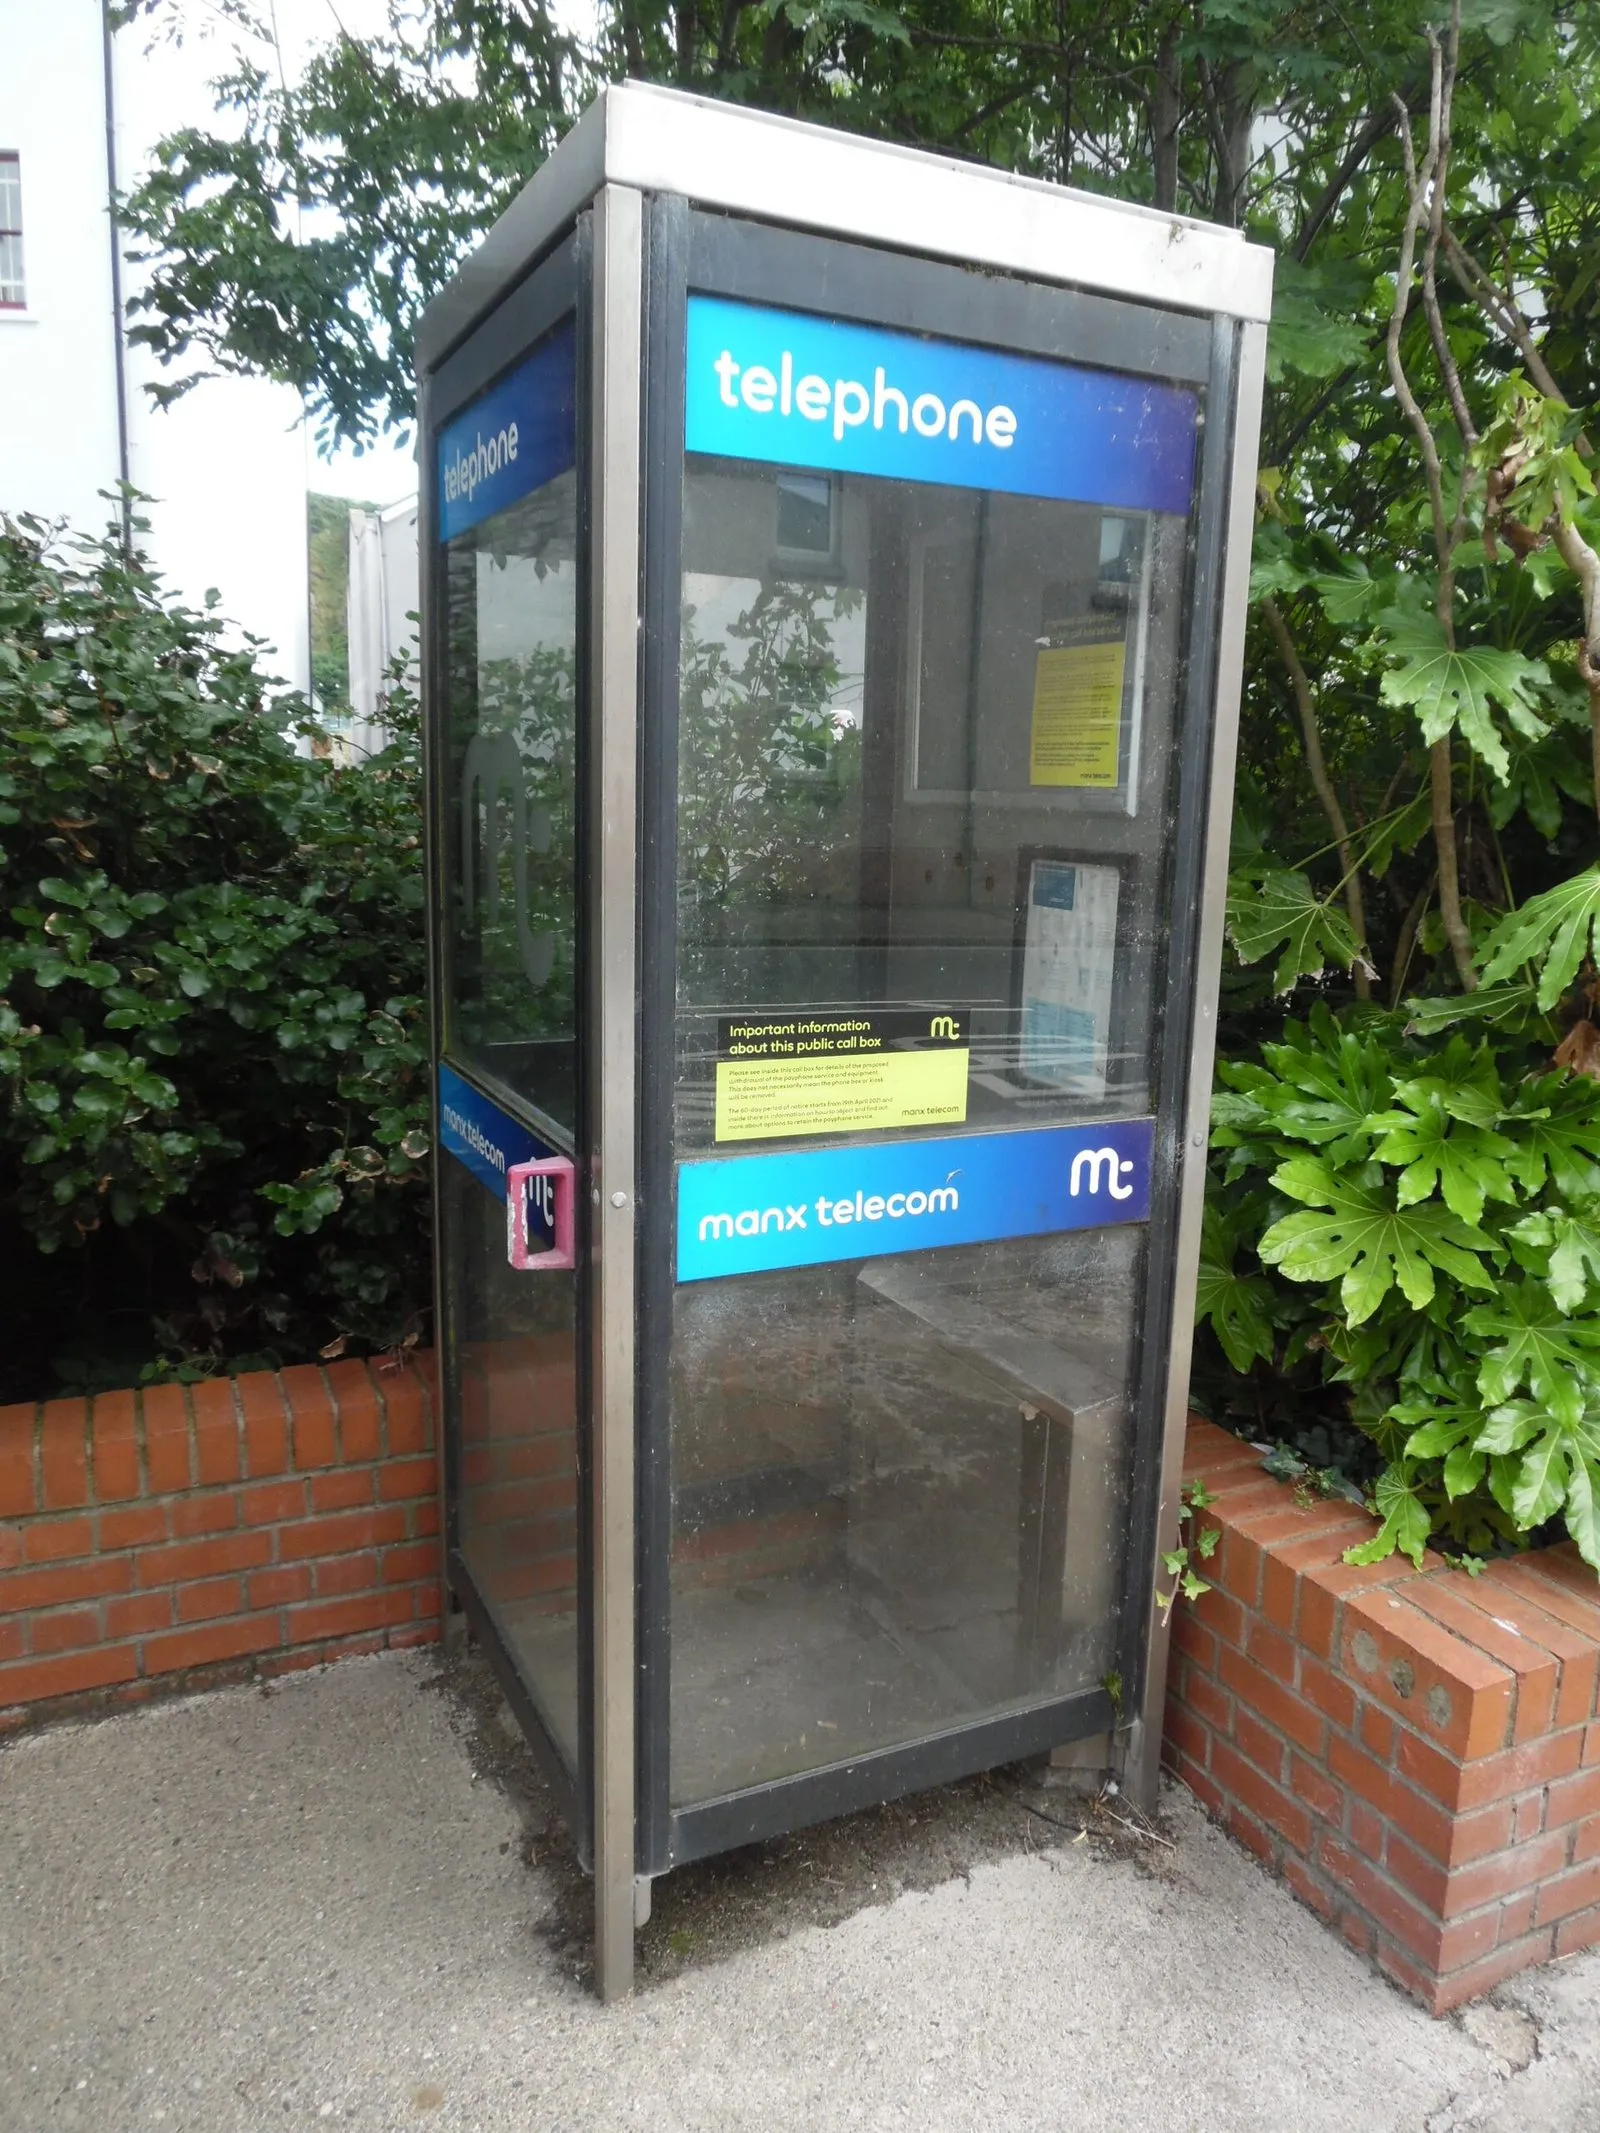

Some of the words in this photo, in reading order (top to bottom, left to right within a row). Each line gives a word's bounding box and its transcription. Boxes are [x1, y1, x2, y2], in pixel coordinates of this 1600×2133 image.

[713, 349, 1018, 449] telephone
[444, 421, 519, 503] telephone
[729, 1042, 768, 1055] about
[771, 1039, 794, 1053] this
[797, 1037, 833, 1054] public
[836, 1037, 857, 1050] call
[859, 1035, 881, 1048] box
[730, 1022, 795, 1039] Important
[798, 1019, 871, 1035] information
[832, 1079, 850, 1087] phone
[901, 1108, 925, 1117] manx
[927, 1105, 959, 1115] telecom
[443, 1104, 466, 1138] manx
[467, 1118, 506, 1174] telecom
[698, 1201, 808, 1241] manx
[815, 1186, 959, 1226] telecom
